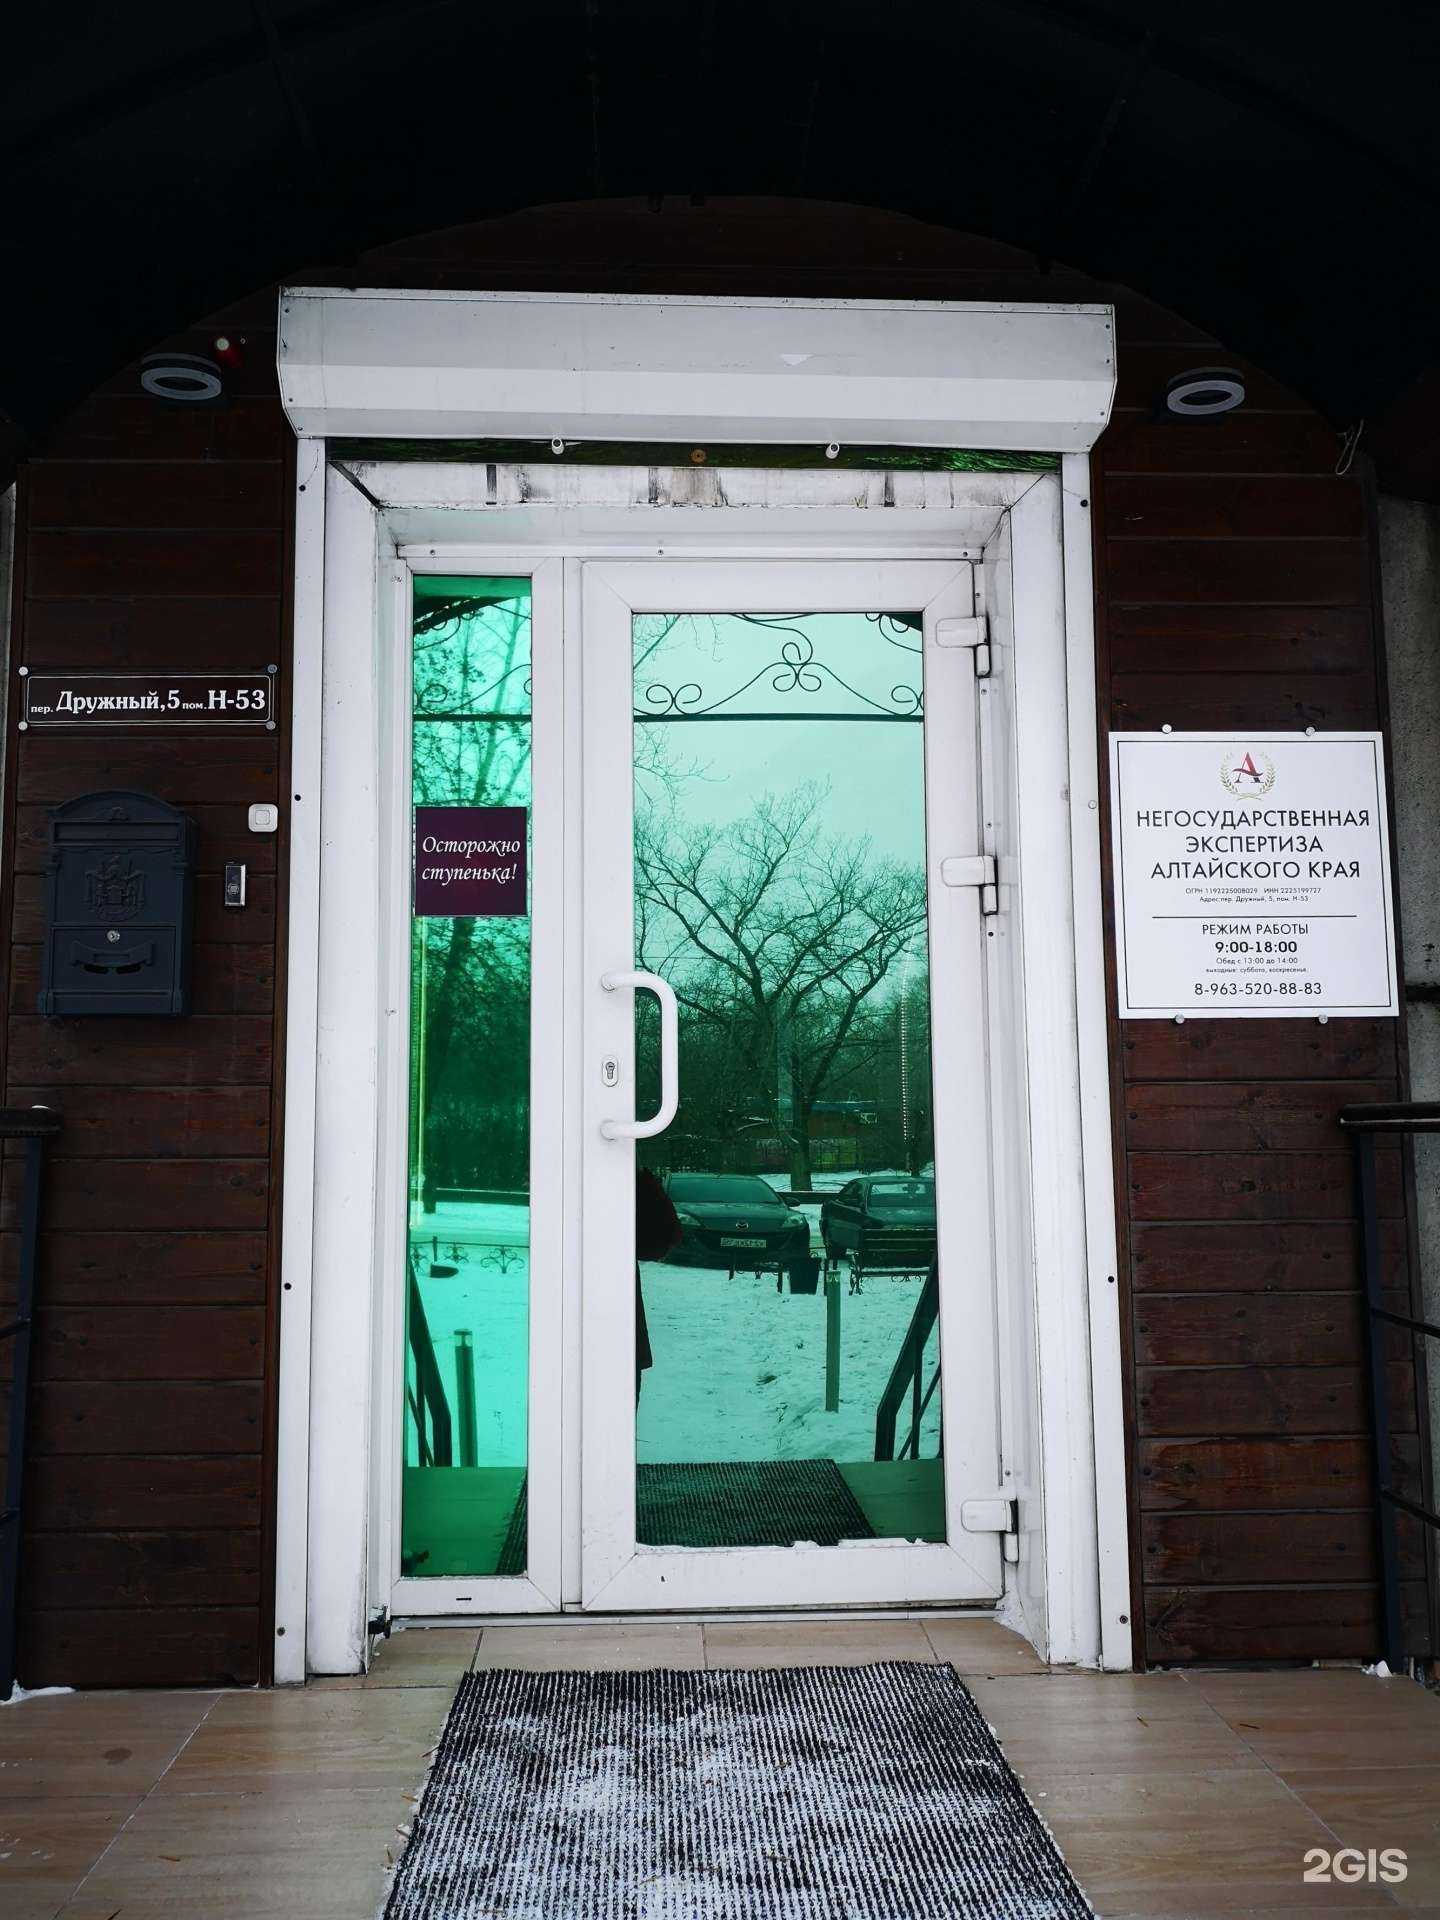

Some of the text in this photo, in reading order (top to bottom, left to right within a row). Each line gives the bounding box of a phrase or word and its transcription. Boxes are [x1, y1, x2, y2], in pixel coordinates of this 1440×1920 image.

[31, 704, 54, 714] пер.
[182, 702, 208, 710] пом.
[208, 689, 267, 710] Н-53
[1136, 809, 1370, 830] НЕГОСУДАРСТВЕННАЯ
[422, 836, 521, 859] Осторожно
[1185, 835, 1324, 853] ЭКСПЕРТИЗА
[421, 863, 518, 886] ступенька!
[1150, 857, 1361, 879] АЛТАЙСКОГО КРАЯ
[1185, 887, 1203, 895] ОГРН
[1205, 887, 1258, 895] 1192225008029
[1202, 923, 1309, 936] РЕЖИМ РАБОТЫ
[1214, 941, 1298, 954] 9:00-18:00
[1216, 956, 1236, 966] Обед
[1243, 957, 1265, 965] 13:00
[1194, 982, 1322, 996] 8-963-520-88-83
